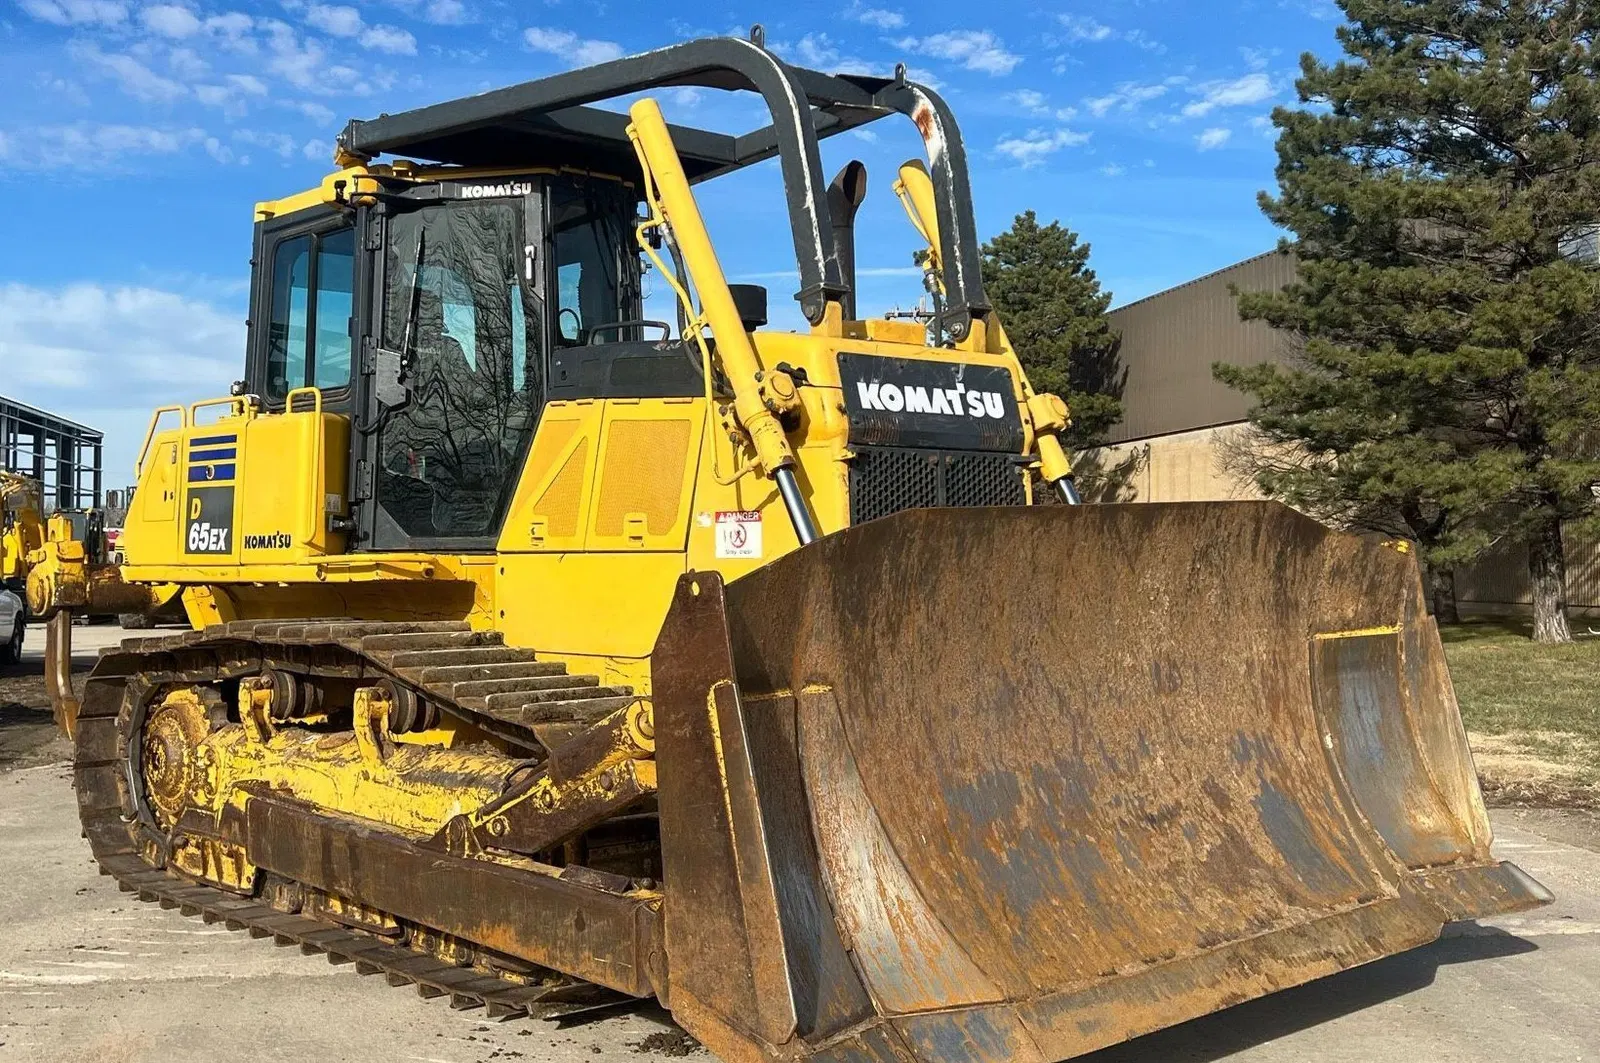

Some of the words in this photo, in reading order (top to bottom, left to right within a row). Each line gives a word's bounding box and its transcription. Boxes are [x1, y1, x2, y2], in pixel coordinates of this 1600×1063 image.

[461, 181, 532, 198] KOMATSU
[856, 381, 1005, 419] KOMATSU
[190, 497, 201, 520] D
[726, 511, 760, 521] DANGER
[188, 522, 228, 551] 65EX
[244, 530, 292, 549] KOMATSU
